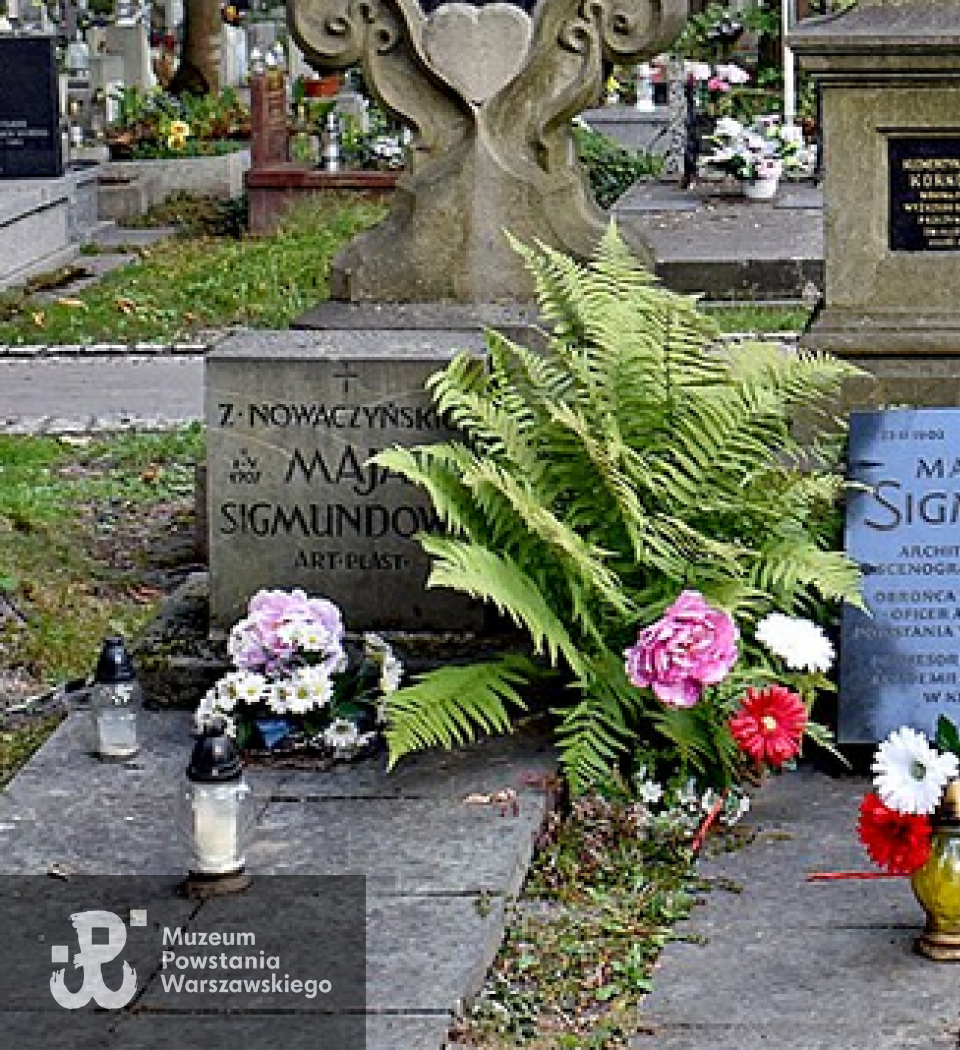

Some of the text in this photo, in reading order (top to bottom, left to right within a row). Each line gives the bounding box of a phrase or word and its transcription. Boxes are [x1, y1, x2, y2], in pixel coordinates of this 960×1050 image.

[220, 503, 455, 539] SIGMUNDOW
[875, 588, 956, 603] OBROŃCA
[890, 607, 951, 620] OFICER
